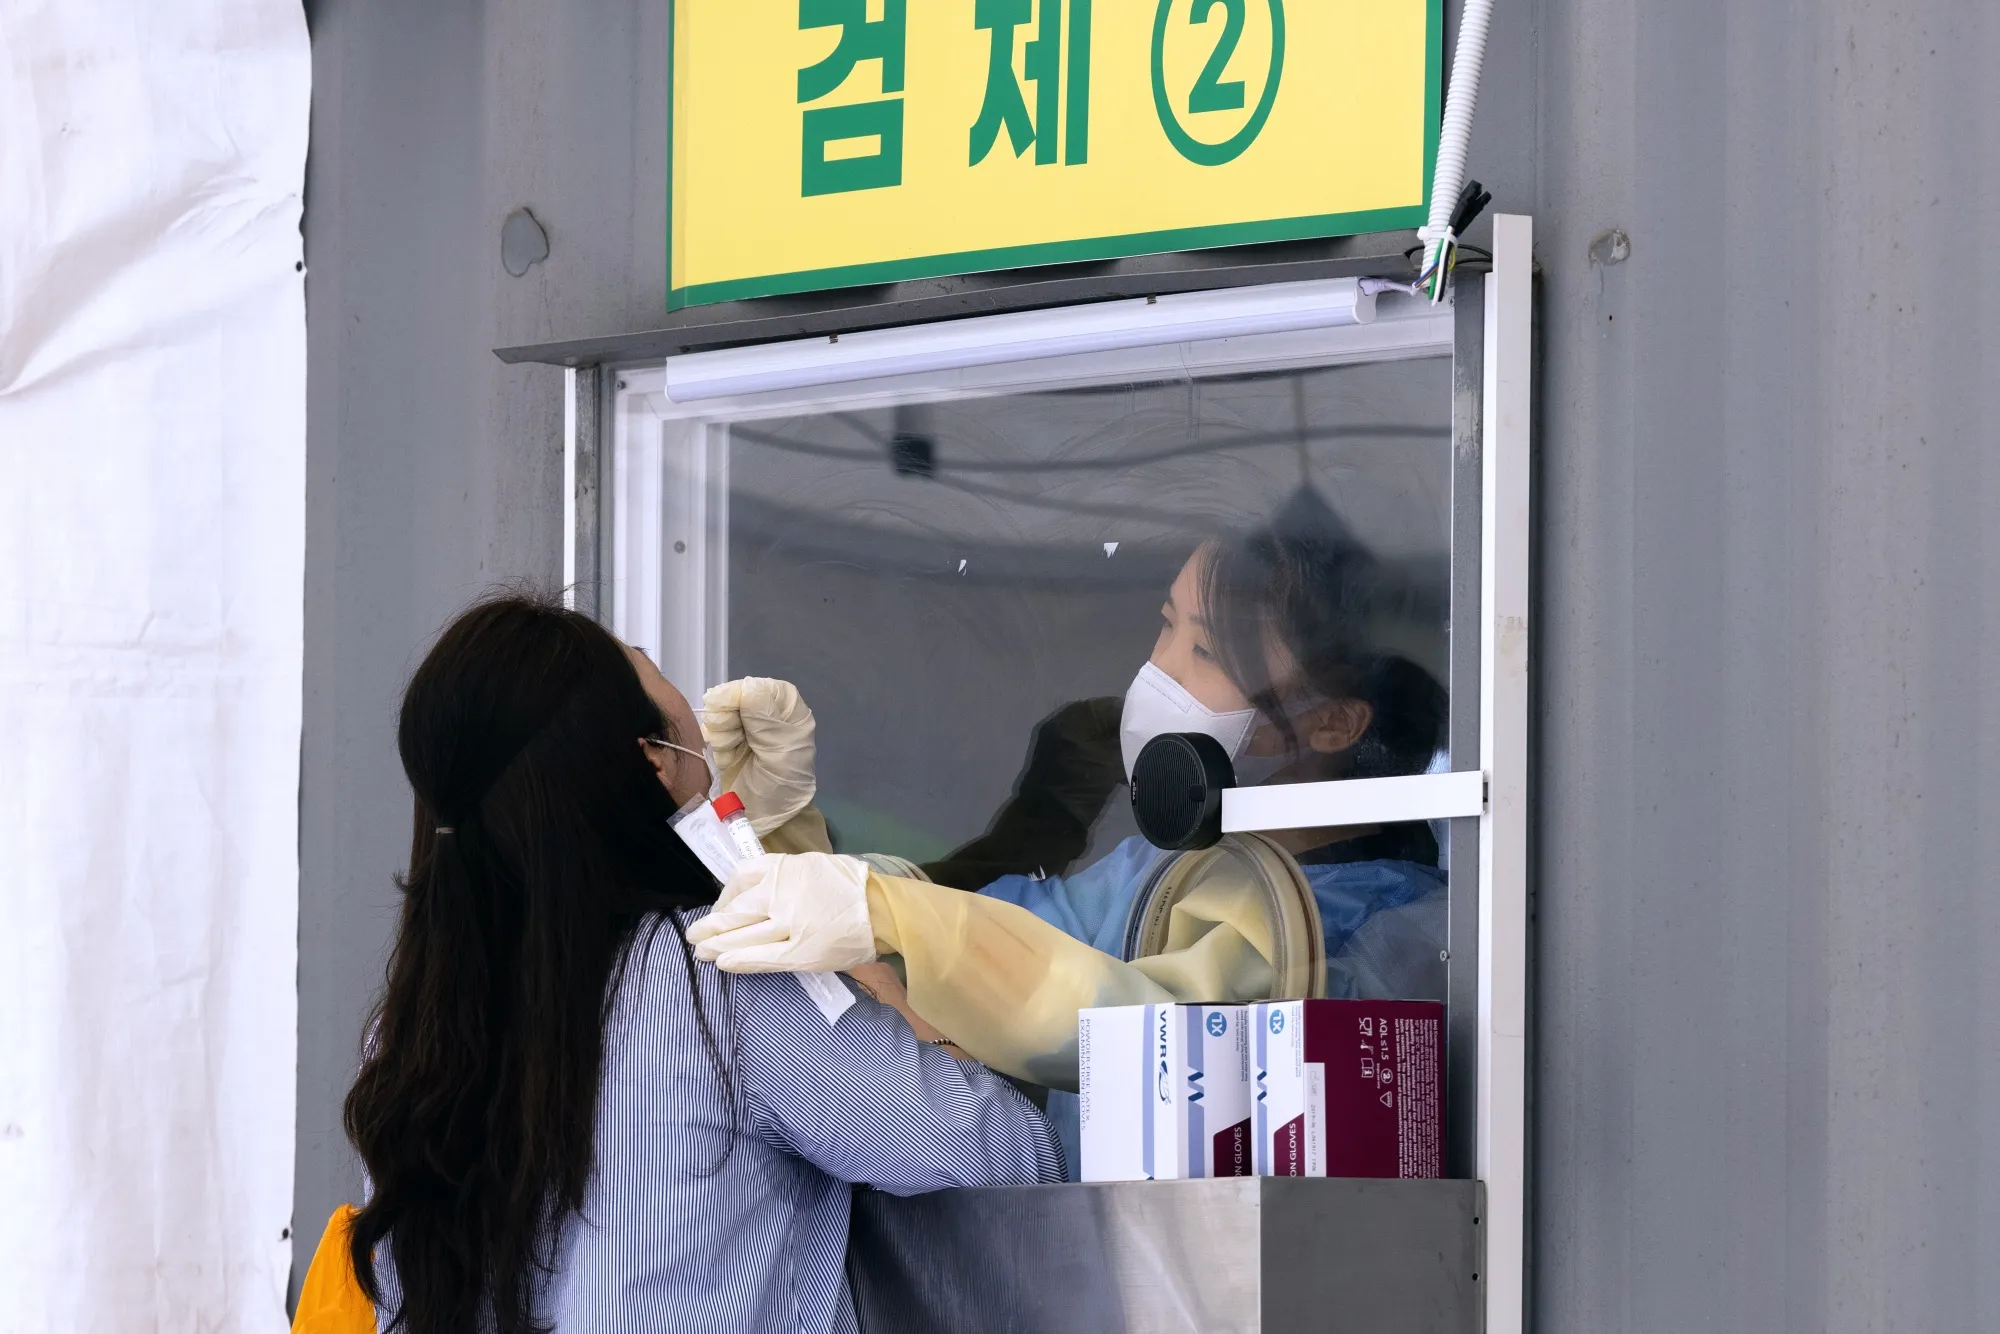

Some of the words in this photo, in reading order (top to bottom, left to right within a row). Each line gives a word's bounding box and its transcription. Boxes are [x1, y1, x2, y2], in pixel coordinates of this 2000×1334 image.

[1211, 1014, 1223, 1034] XL
[1273, 1012, 1282, 1032] XL
[1379, 1018, 1388, 1038] AQL
[1234, 1126, 1242, 1164] GLOVES
